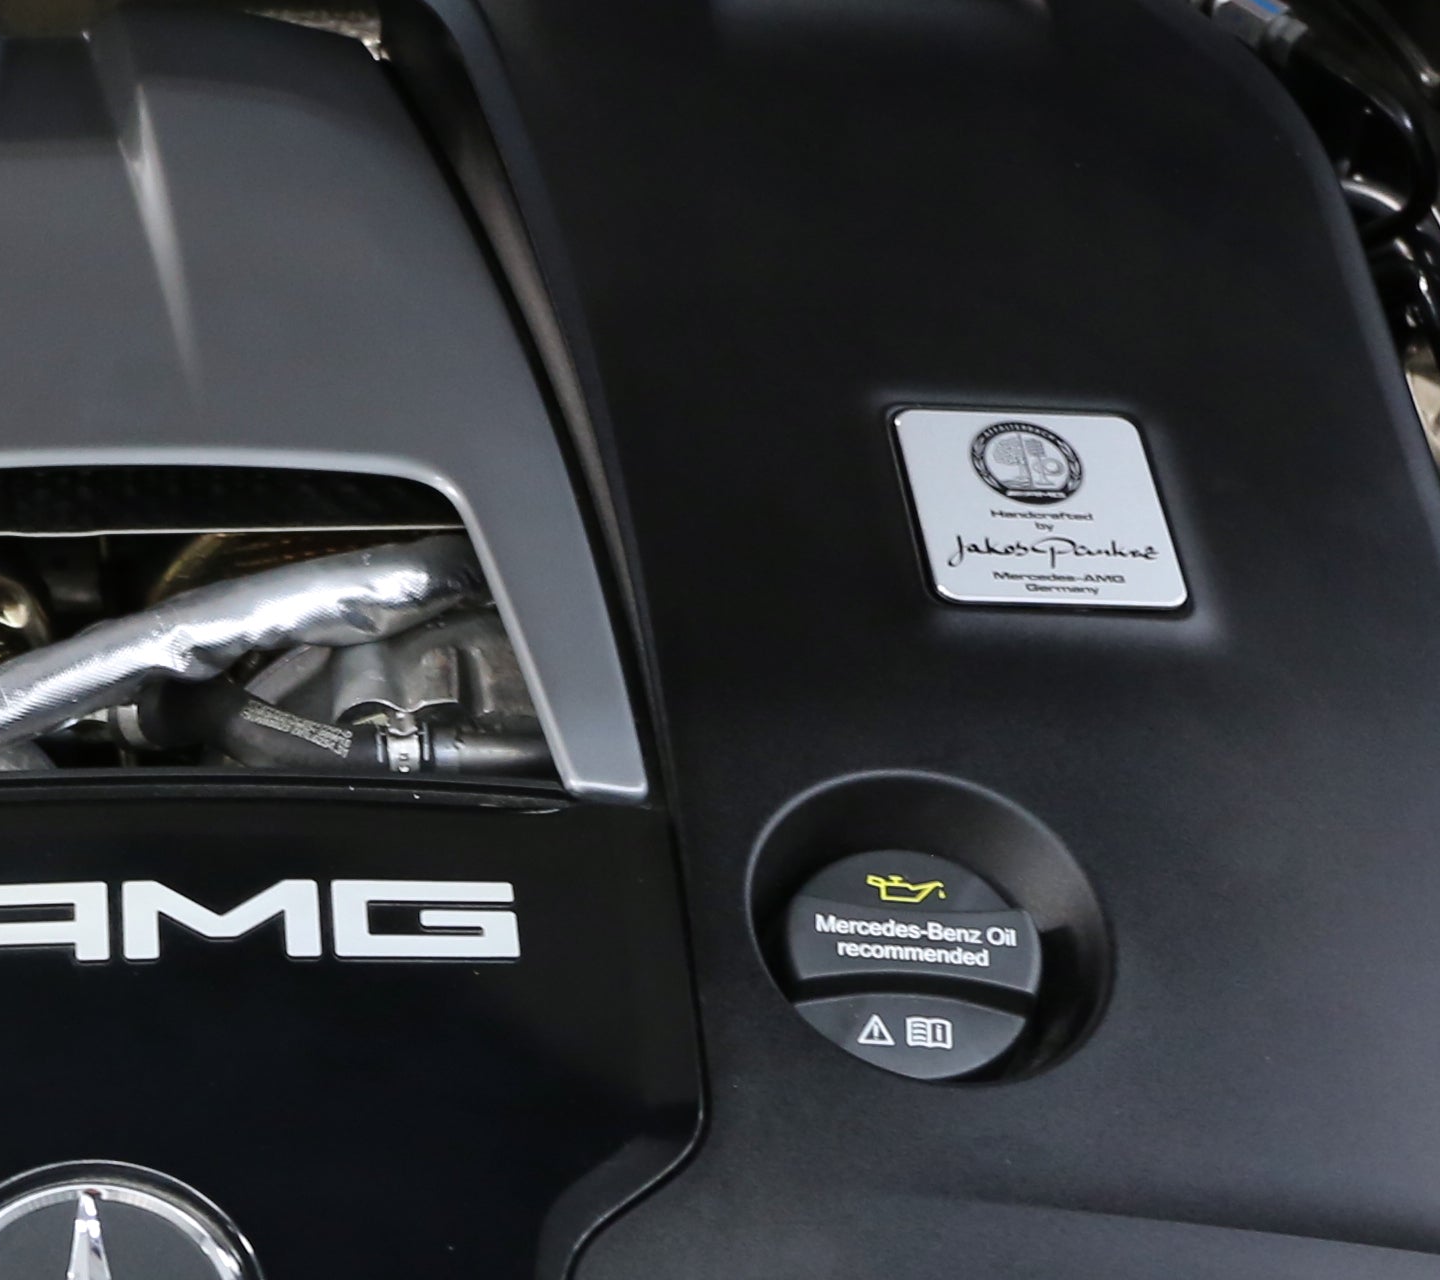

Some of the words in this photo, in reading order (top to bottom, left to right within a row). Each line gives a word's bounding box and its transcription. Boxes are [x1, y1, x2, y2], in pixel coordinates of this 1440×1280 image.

[990, 509, 1094, 521] Handcrafted
[1034, 521, 1055, 532] by
[992, 570, 1126, 584] Mercedes-AMG
[1025, 583, 1100, 595] Germany
[814, 913, 983, 945] Mercedes-Benz
[985, 926, 1018, 947] Oil
[836, 940, 990, 967] recommended
